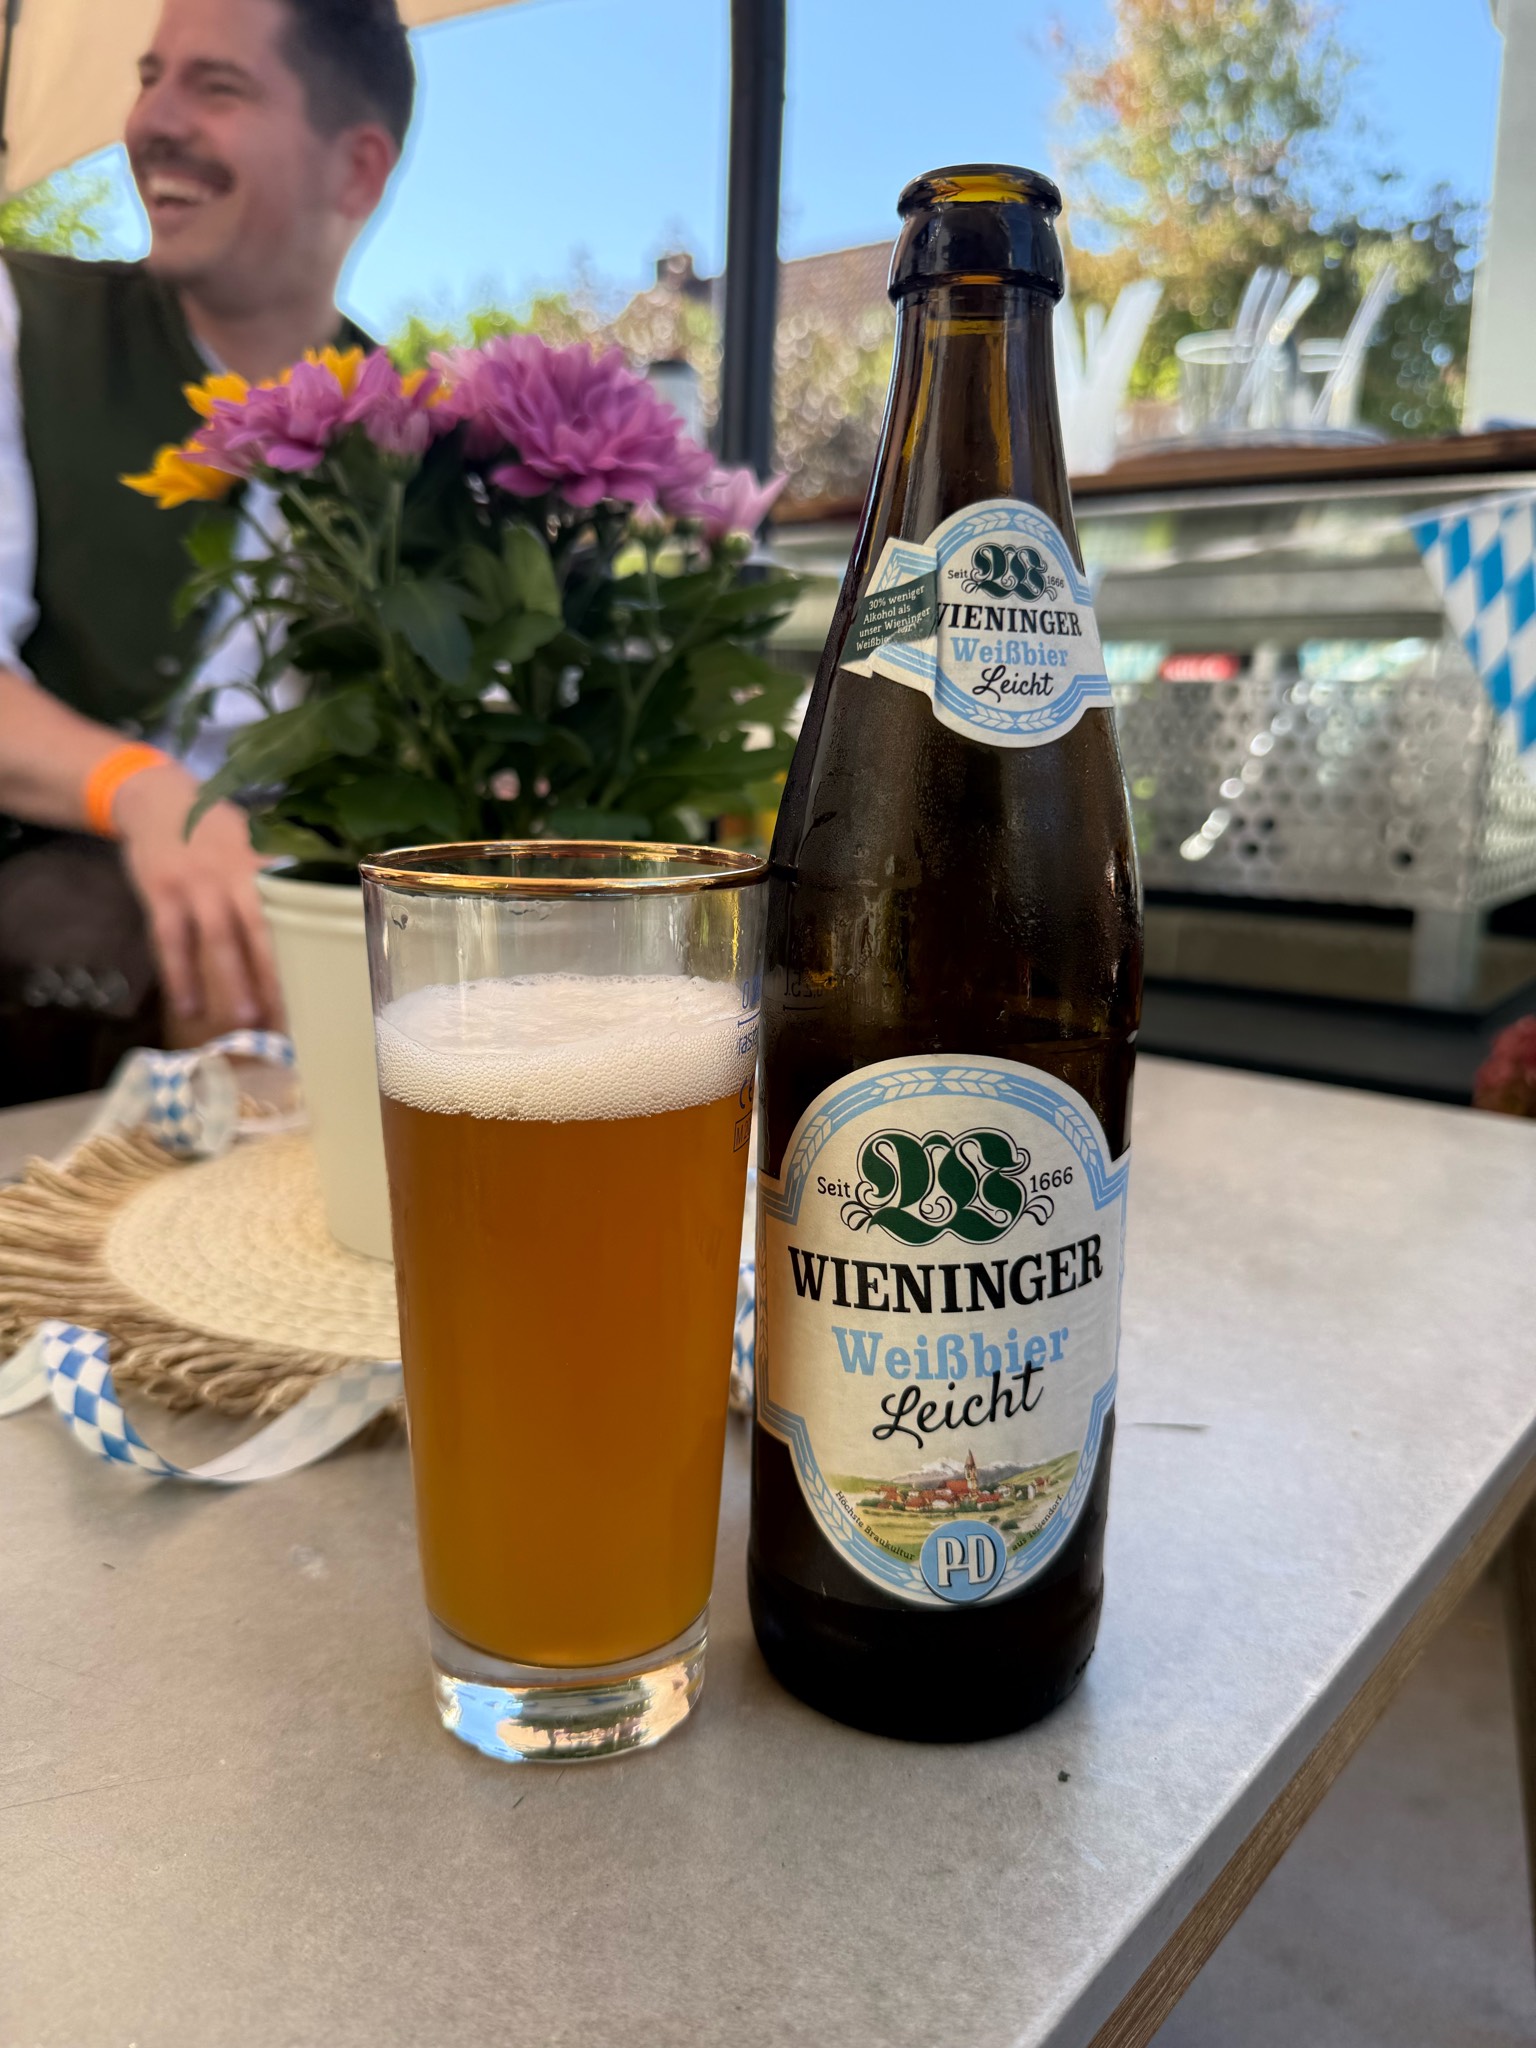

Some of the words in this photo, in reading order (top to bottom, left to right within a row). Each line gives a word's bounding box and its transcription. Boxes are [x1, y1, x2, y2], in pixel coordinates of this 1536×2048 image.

[947, 569, 969, 580] Seit
[1046, 575, 1065, 589] 1666
[868, 597, 886, 611] 30%
[888, 585, 925, 606] weniger
[859, 625, 882, 638] unser
[884, 606, 931, 631] Wieninger
[863, 606, 896, 625] Alkohol
[898, 604, 911, 615] als
[950, 636, 1069, 668] Weißbier
[972, 664, 1054, 704] Leicht
[816, 1175, 851, 1199] Seit
[1029, 1166, 1074, 1195] 1666
[787, 1232, 1104, 1314] WIENINGER
[831, 1325, 1070, 1381] Weißbier
[871, 1360, 1045, 1449] Leicht
[835, 1490, 864, 1528] Höchste
[864, 1525, 916, 1561] Braukultur
[1012, 1536, 1028, 1552] aus
